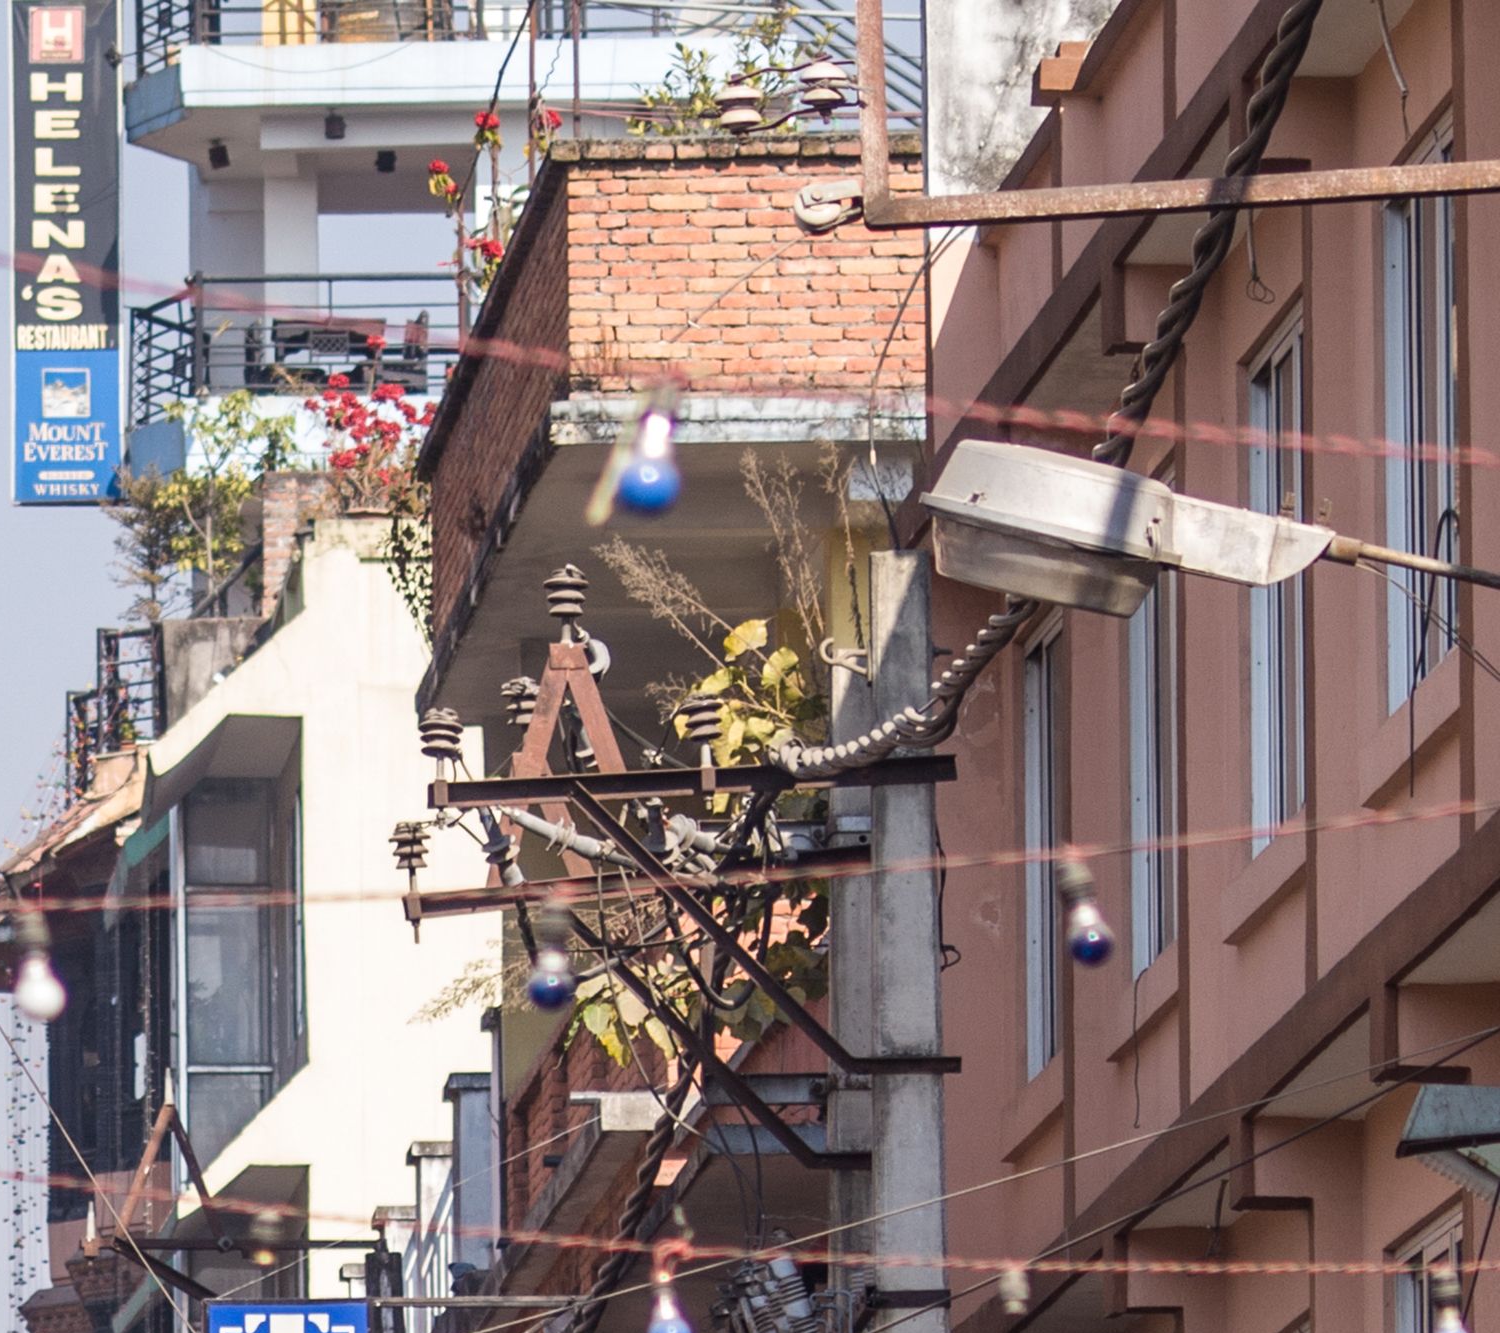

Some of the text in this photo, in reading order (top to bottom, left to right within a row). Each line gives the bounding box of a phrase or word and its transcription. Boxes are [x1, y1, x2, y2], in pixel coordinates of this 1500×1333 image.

[17, 325, 108, 351] RESTAURANT
[28, 421, 106, 442] MOUNT
[23, 441, 109, 463] EVEREST
[33, 483, 100, 496] WHISKY
